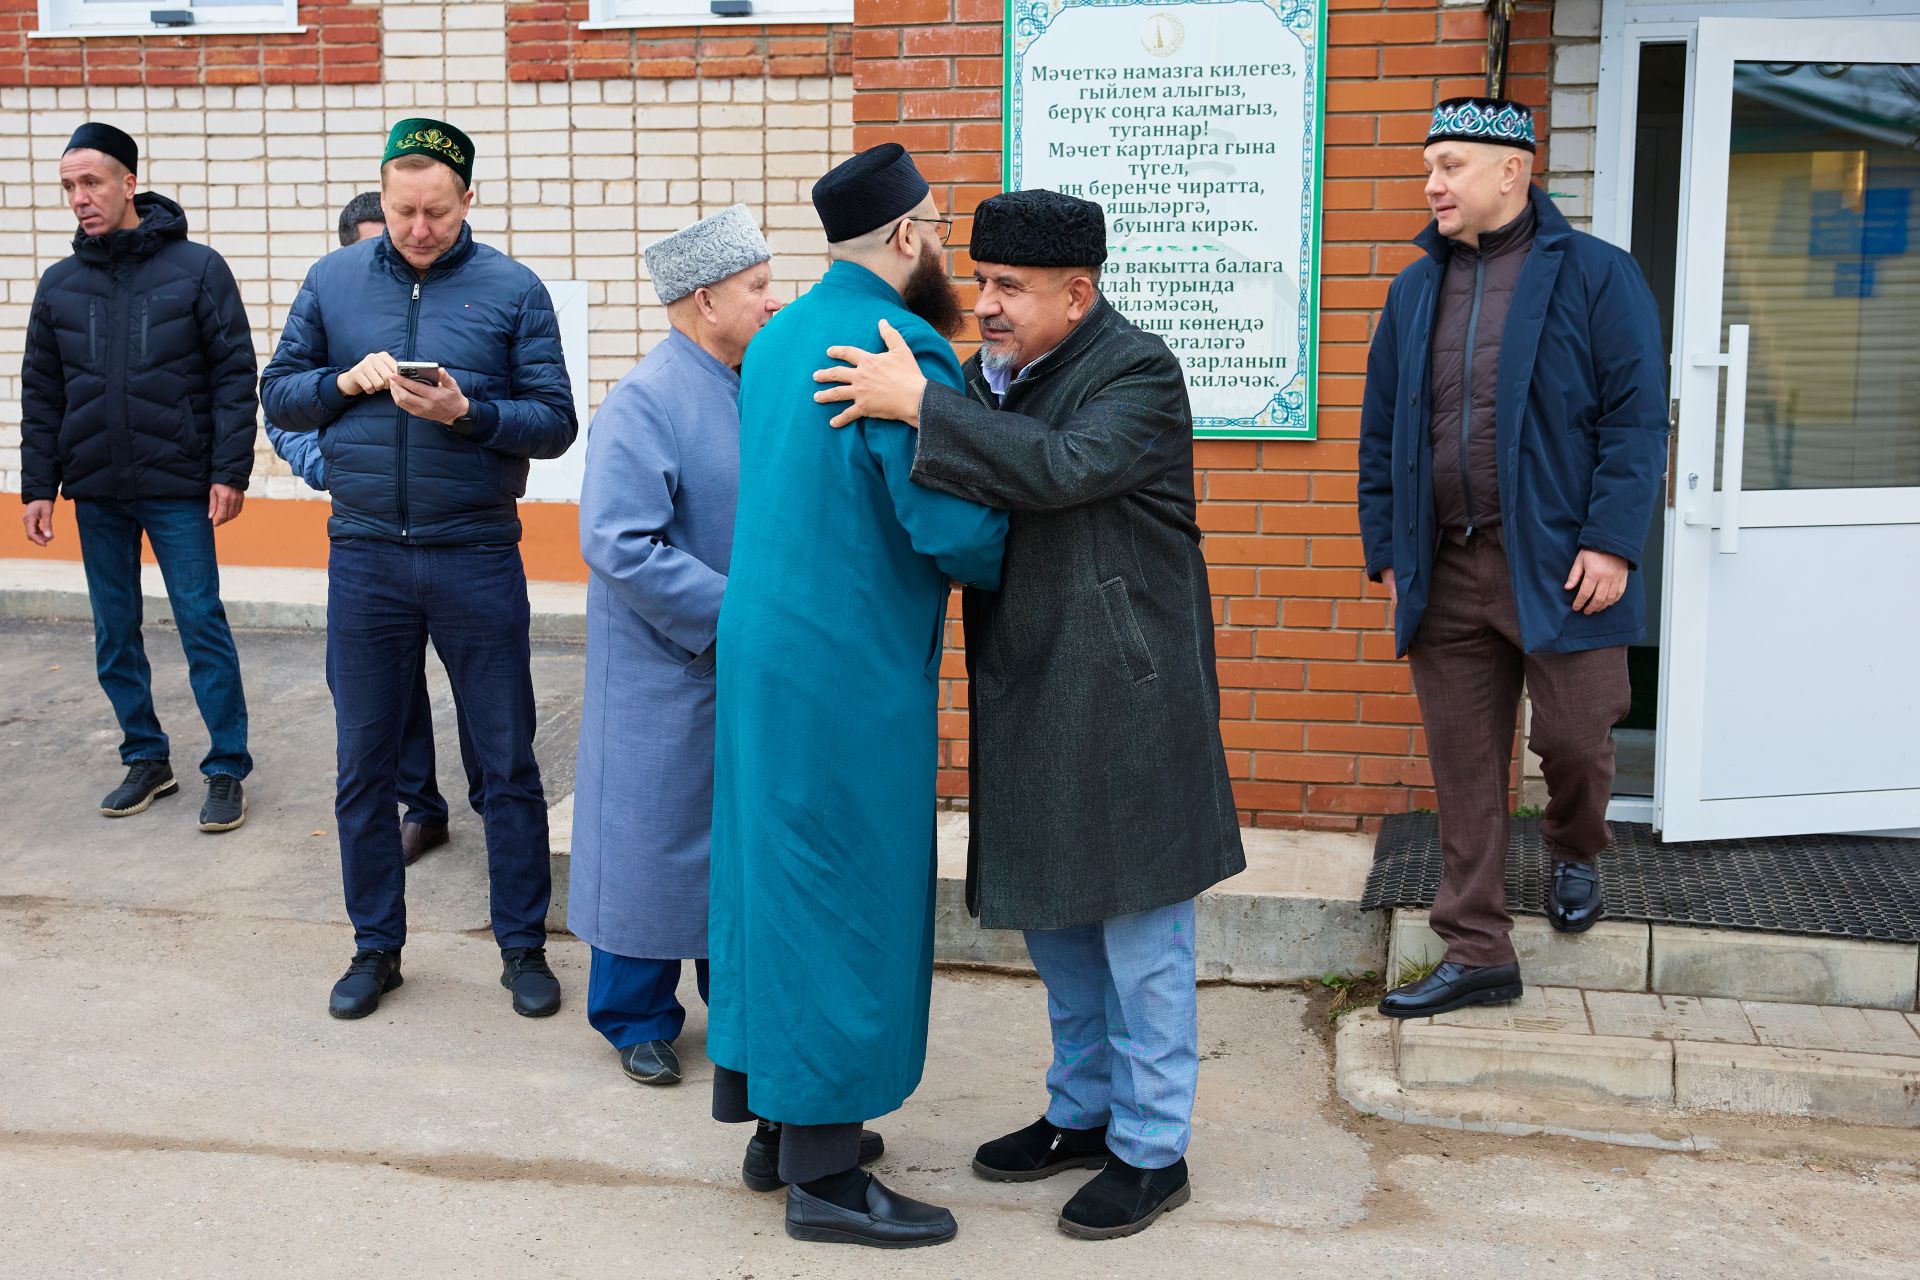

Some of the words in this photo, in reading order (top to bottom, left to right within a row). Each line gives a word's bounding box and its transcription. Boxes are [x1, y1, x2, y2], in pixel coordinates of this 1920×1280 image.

[1031, 65, 1116, 81] Мәчеткә
[1123, 66, 1202, 79] намазга
[1210, 63, 1295, 77] килегез,
[1079, 83, 1156, 99] гыйлем
[1162, 84, 1245, 97] алыгыз,
[1048, 103, 1105, 123] берүк
[1111, 105, 1165, 120] соңга
[1172, 103, 1276, 117] калмагыз,
[1109, 120, 1208, 141] туганнар!
[1048, 142, 1110, 157] Мәчет
[1116, 143, 1218, 160] картларга
[1225, 142, 1275, 154] гына
[1128, 163, 1188, 179] түгел,
[1088, 179, 1170, 199] беренче
[1177, 181, 1264, 198] чиратта,
[1106, 201, 1209, 217] яшьләргә,
[1113, 217, 1185, 237] буынга
[1191, 220, 1257, 236] кирәк.
[1125, 261, 1209, 273] вакытта
[1215, 257, 1282, 273] балага
[1146, 280, 1234, 296] турында
[1179, 318, 1263, 333] көнеңдә
[1186, 356, 1286, 372] зарланып
[1189, 375, 1279, 387] киләчәк.
